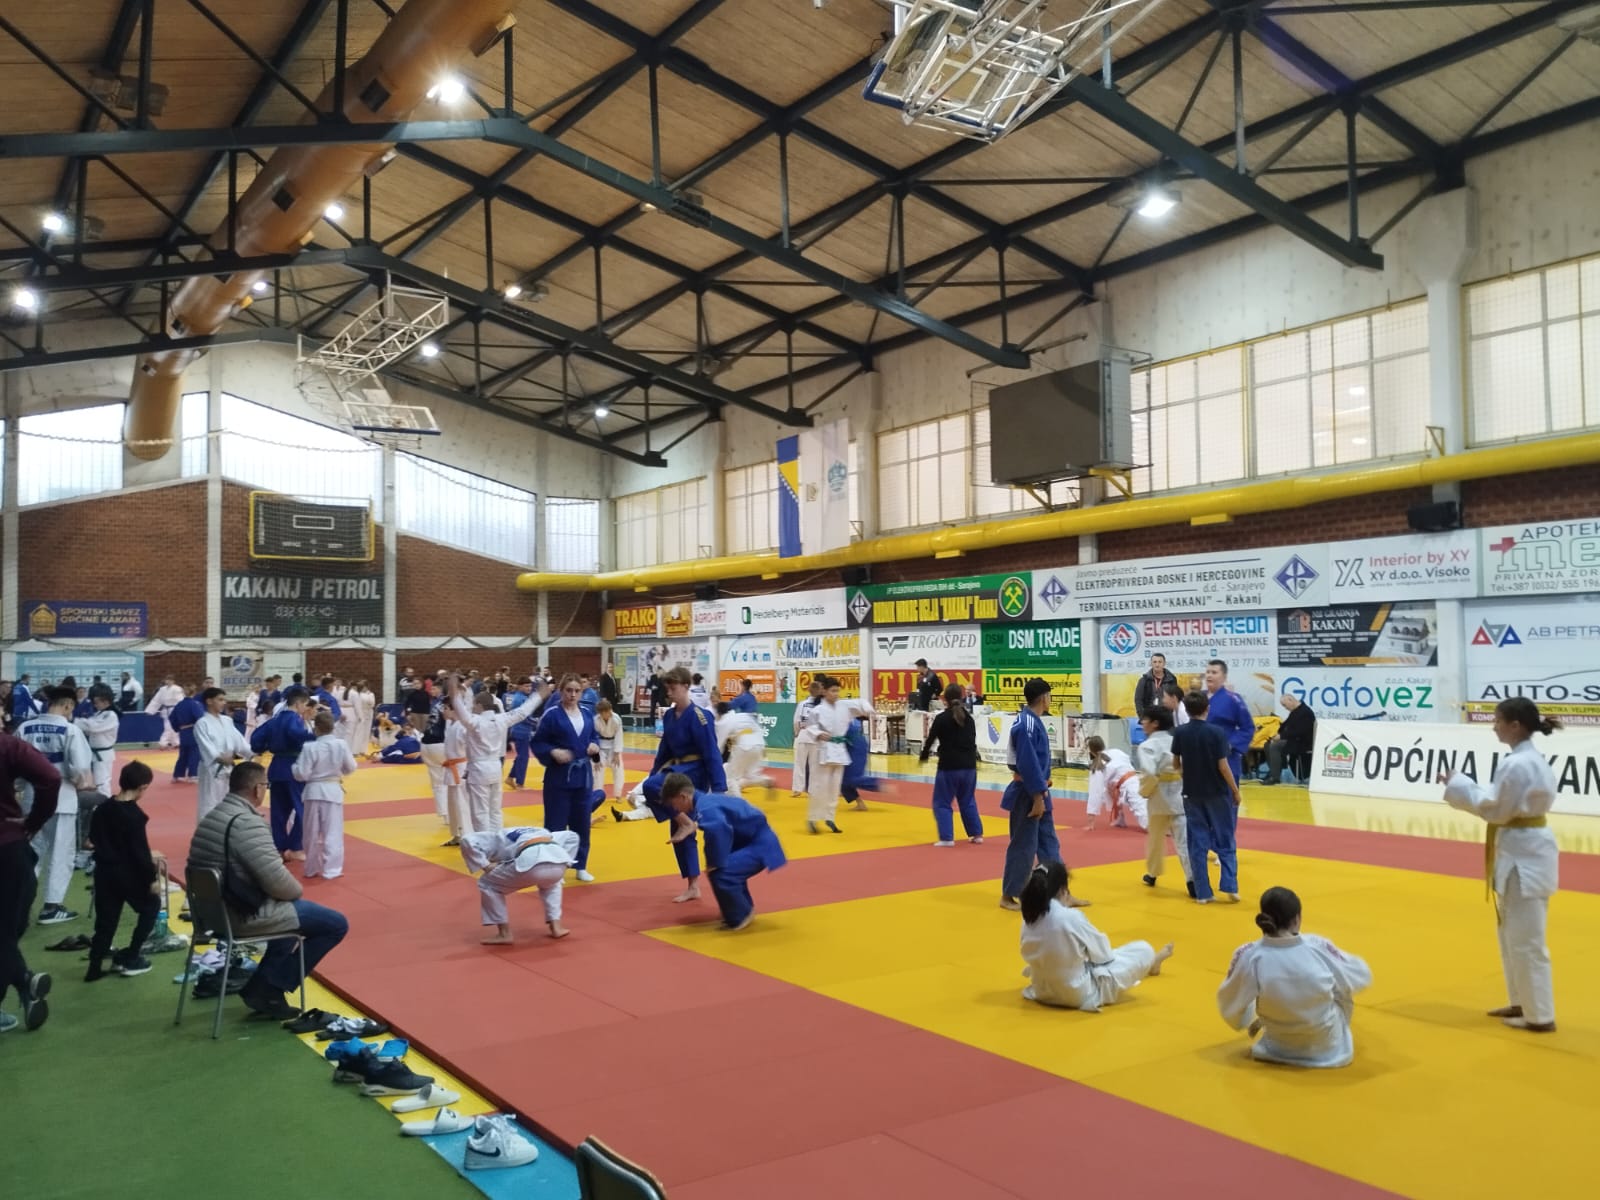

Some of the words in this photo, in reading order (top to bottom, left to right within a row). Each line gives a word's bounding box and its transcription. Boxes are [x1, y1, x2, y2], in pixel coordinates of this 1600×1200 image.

[1369, 552, 1422, 567] Interior
[1427, 552, 1445, 566] by
[1450, 549, 1470, 561] XY
[1075, 576, 1154, 591] ELEKTROPRIVREDA
[1157, 572, 1187, 586] BOSNE
[1197, 567, 1265, 582] HERCEGOVINE
[1370, 571, 1386, 581] XY
[1389, 569, 1422, 580] d.o.o.
[1425, 566, 1470, 578] Visoko
[1494, 571, 1564, 581] PRIVATNA
[225, 576, 300, 598] KAKANJ
[311, 578, 381, 600] PETROL
[1227, 581, 1265, 593] Sarajevo
[1079, 598, 1160, 613] TERMOELEKTRANA
[1225, 594, 1262, 605] Kakanj
[616, 607, 656, 627] TRAKO
[1312, 619, 1355, 631] KAKANJ
[226, 625, 270, 636] KAKANJ
[1009, 630, 1034, 649] DSM
[1037, 627, 1080, 648] TRADE
[1528, 627, 1551, 637] AB
[911, 631, 977, 650] TRGOŠPED
[1145, 639, 1173, 648] SERVIS
[1175, 637, 1226, 647] RASHLADNE
[1229, 636, 1269, 646] TEHNIKE
[1281, 677, 1433, 708] Grafovez
[1364, 737, 1478, 785] OPĆINA
